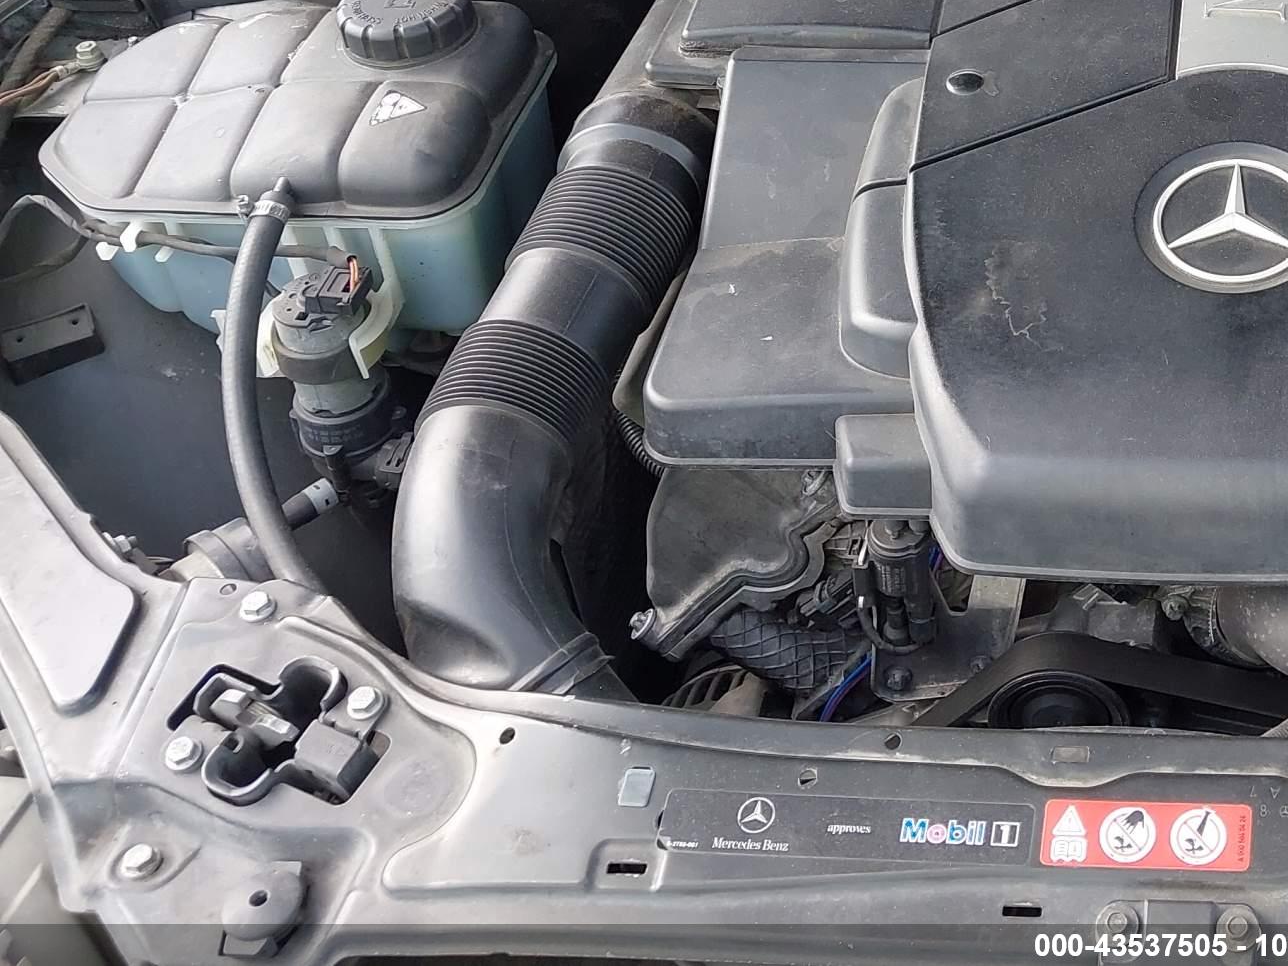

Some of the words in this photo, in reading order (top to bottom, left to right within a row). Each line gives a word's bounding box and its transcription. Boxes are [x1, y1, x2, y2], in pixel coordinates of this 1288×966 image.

[827, 823, 872, 835] approves
[899, 817, 987, 846] Mobil
[711, 837, 761, 851] Mercedes
[762, 839, 790, 852] Benz
